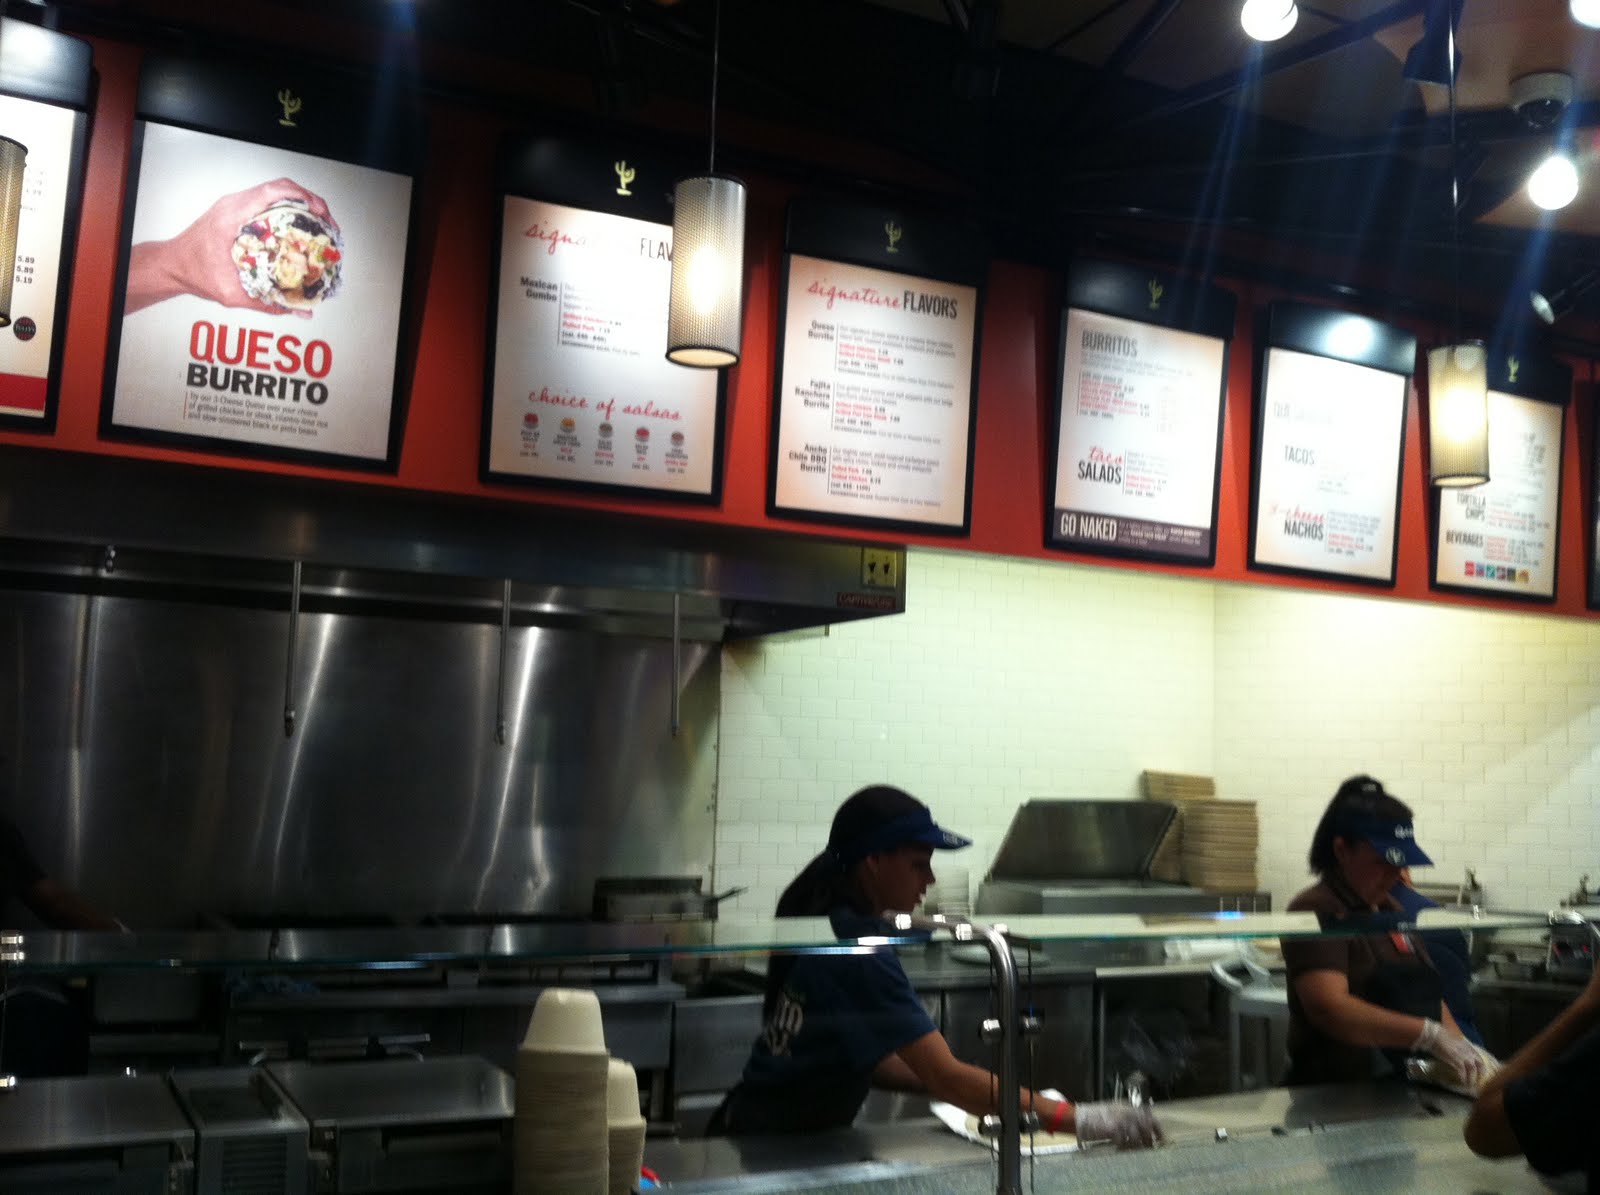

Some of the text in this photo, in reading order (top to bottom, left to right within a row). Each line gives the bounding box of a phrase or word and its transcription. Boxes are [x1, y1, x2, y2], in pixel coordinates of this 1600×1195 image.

[640, 237, 673, 262] FLAV
[525, 288, 558, 302] Gumbo
[807, 278, 958, 319] signature FLAVORS
[189, 320, 332, 378] QUESO
[1082, 330, 1138, 358] BURRITOS
[186, 363, 328, 405] BURRITO
[528, 387, 682, 421] choice of salsas
[804, 443, 828, 454] Ancho
[810, 455, 828, 466] BBQ
[1284, 445, 1315, 466] TACOS
[1078, 460, 1122, 485] SALADS
[1060, 513, 1077, 537] GO
[1080, 516, 1118, 542] NAKED
[1284, 519, 1324, 541] NACHOS
[1446, 530, 1484, 548] BEVERAGES
